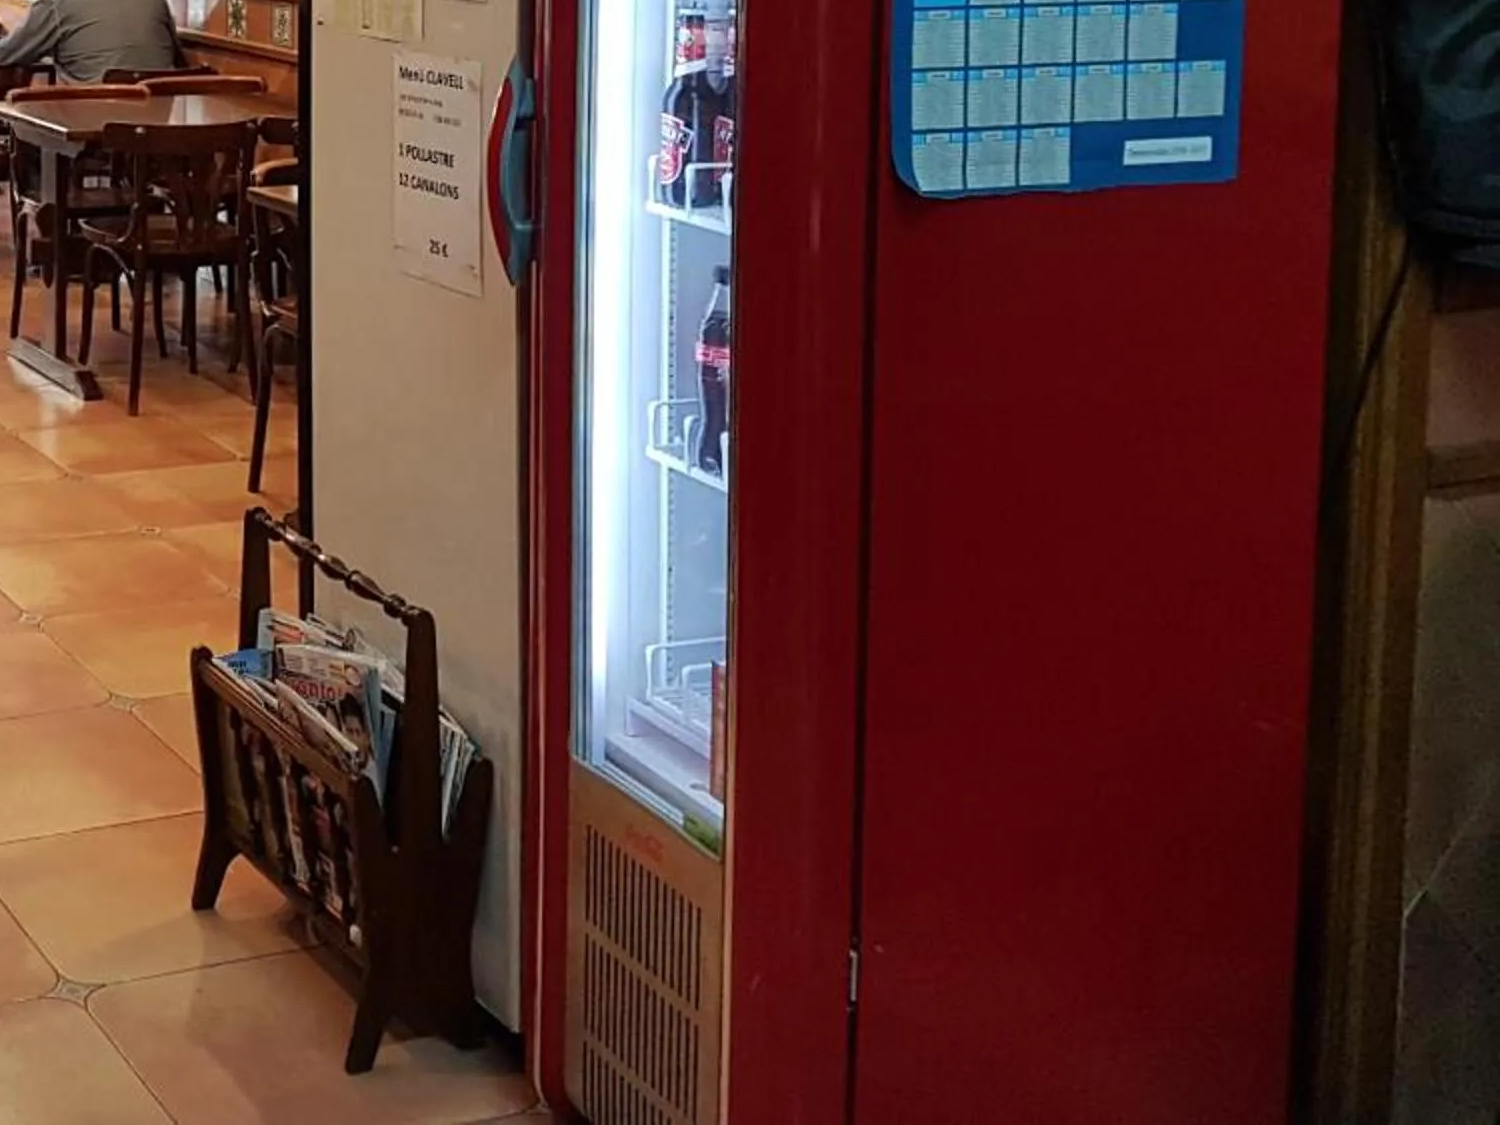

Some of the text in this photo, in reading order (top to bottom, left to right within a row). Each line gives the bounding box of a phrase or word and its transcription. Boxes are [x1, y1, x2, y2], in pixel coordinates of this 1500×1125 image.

[426, 69, 464, 90] CLAVELL
[406, 144, 455, 168] POLLASTRE
[399, 172, 459, 200] 12 CANALONS
